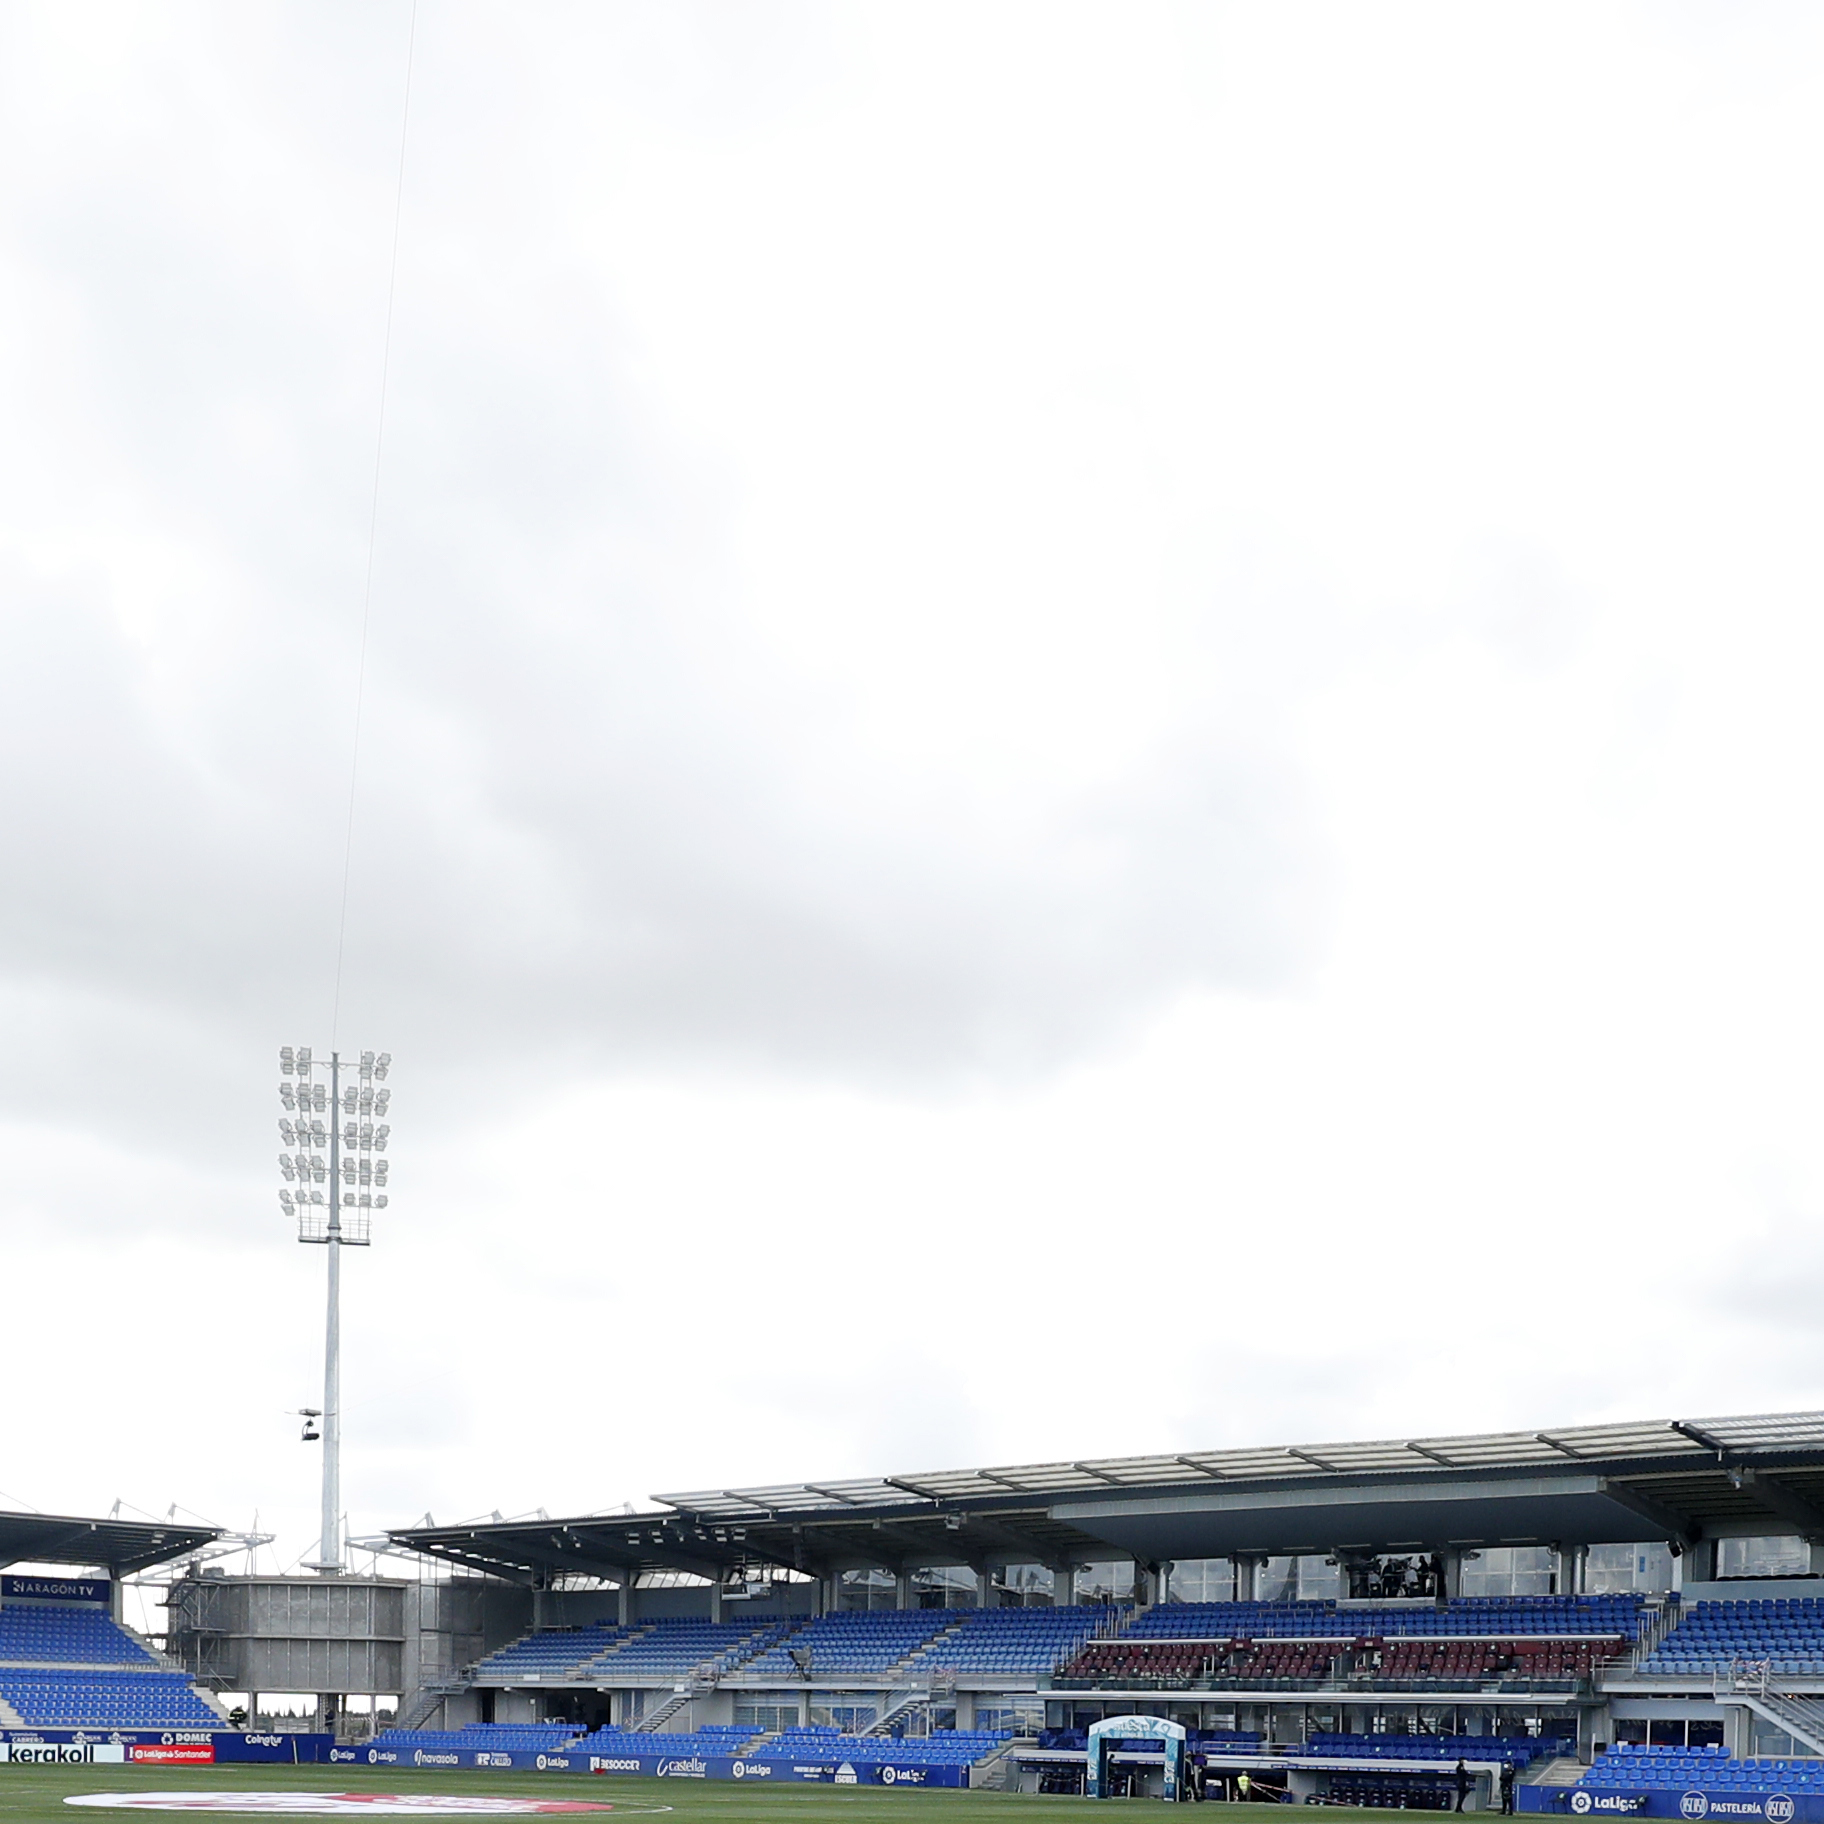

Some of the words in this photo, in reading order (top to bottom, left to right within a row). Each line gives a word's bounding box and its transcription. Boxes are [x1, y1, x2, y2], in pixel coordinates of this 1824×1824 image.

[79, 1585, 95, 1596] TV
[175, 1733, 212, 1742] DOMEC
[8, 1744, 94, 1763] kerakoll
[174, 1749, 212, 1759] Santander
[746, 1764, 772, 1777] LaLiga
